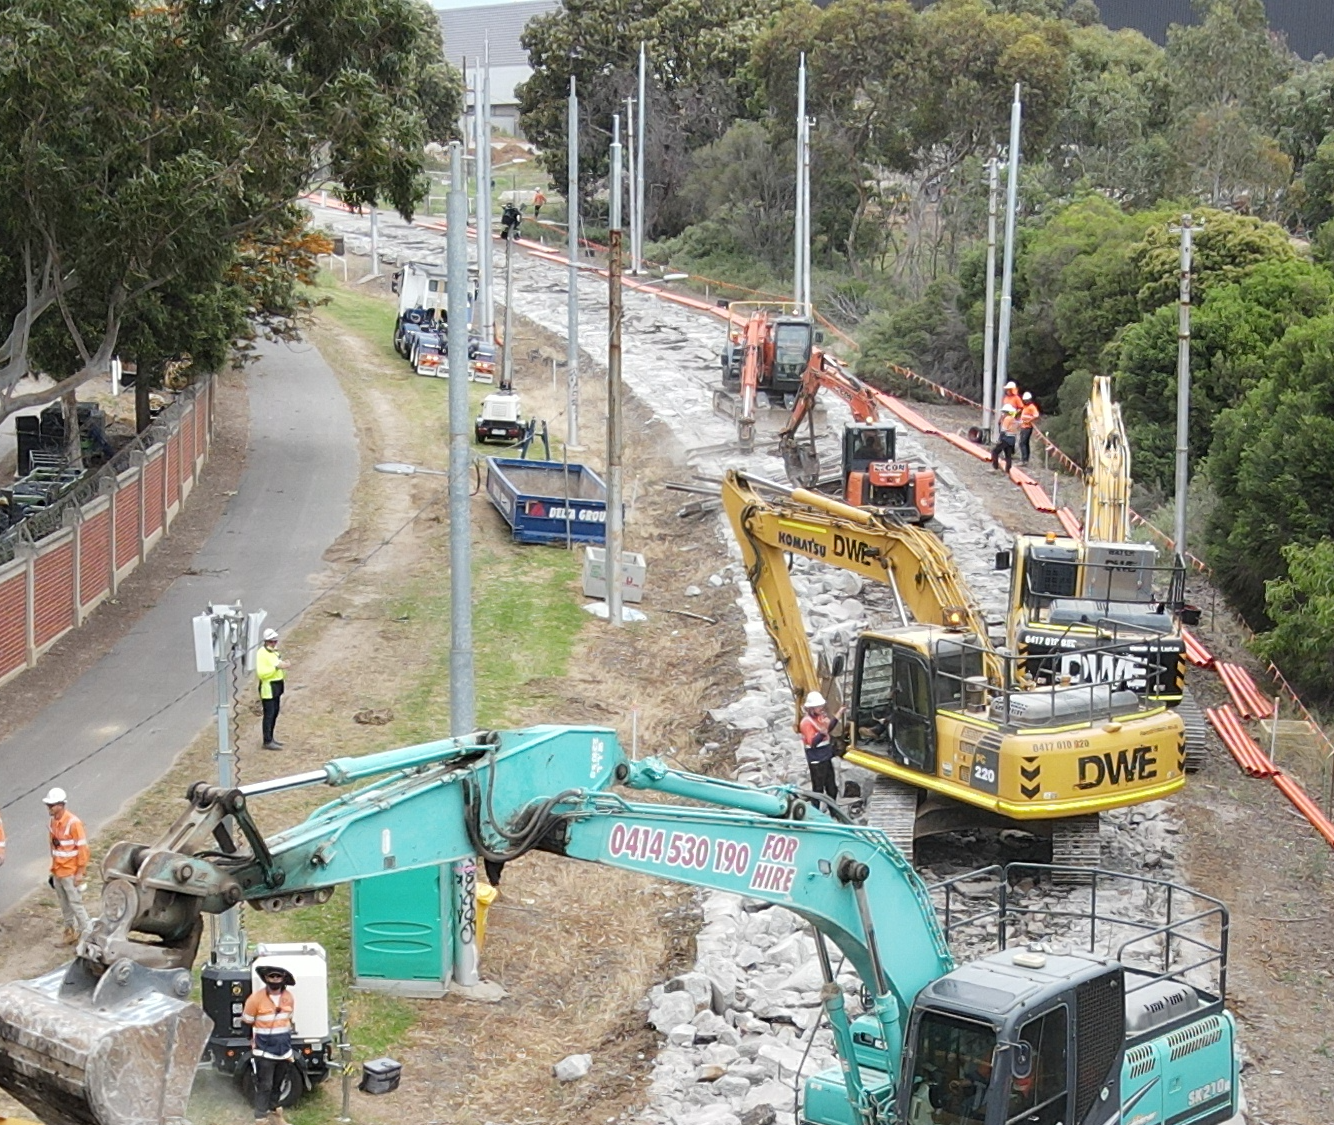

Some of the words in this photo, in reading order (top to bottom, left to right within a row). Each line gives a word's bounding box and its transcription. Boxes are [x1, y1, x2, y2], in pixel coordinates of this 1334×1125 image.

[549, 507, 575, 520] DELA
[579, 509, 606, 522] GROU
[778, 531, 826, 558] KOMATSU
[833, 533, 871, 566] DWE
[1060, 653, 1147, 691] DWE
[976, 753, 986, 764] PC
[1033, 743, 1054, 753] 0417
[1057, 740, 1072, 750] 010
[975, 765, 995, 783] 220
[1076, 745, 1157, 790] DWE
[610, 822, 665, 862] 0414
[666, 832, 710, 869] 530
[713, 839, 750, 876] 190
[761, 833, 799, 864] FOR
[749, 863, 796, 892] HIRE
